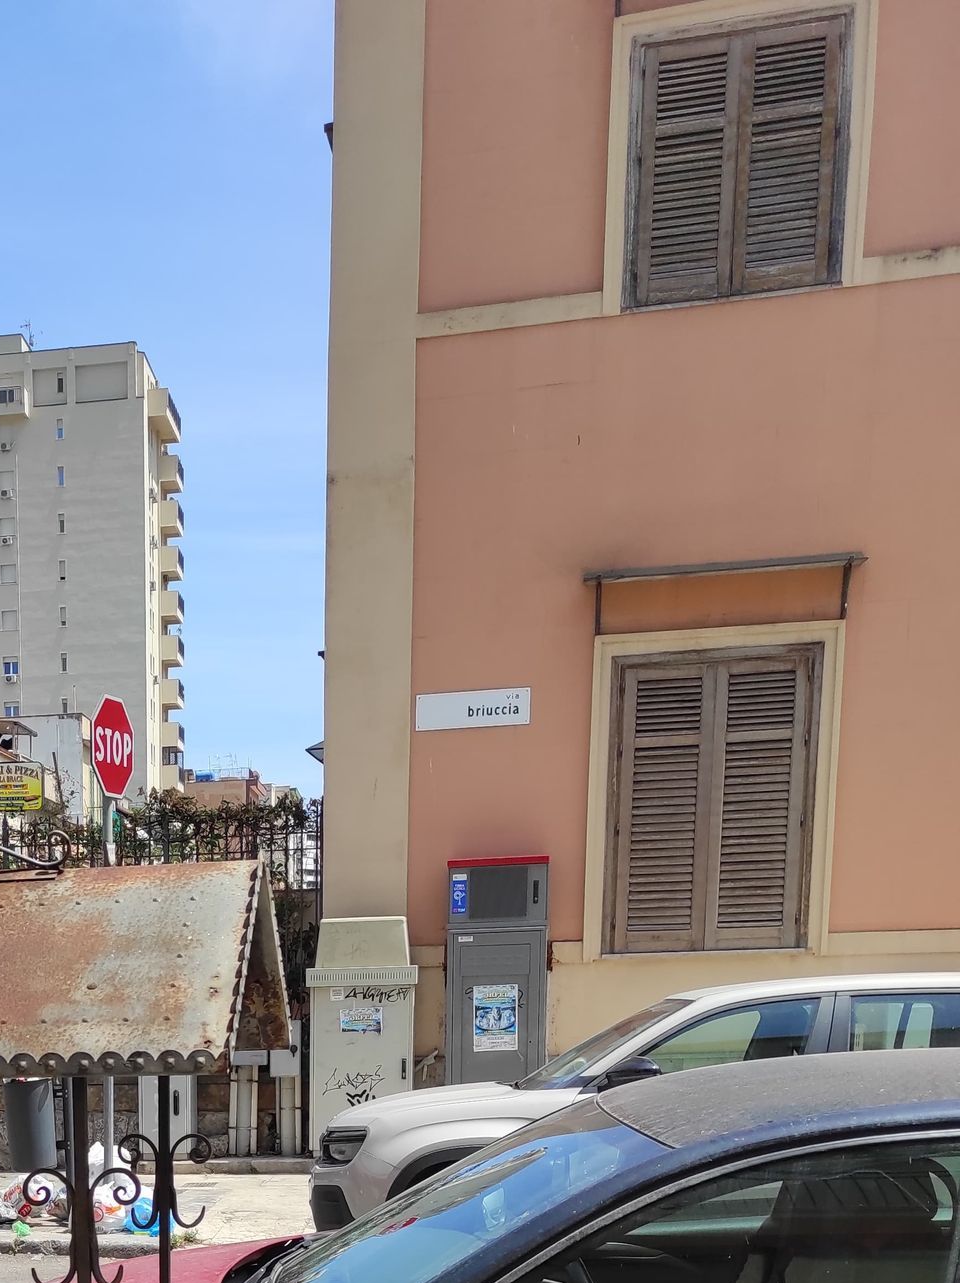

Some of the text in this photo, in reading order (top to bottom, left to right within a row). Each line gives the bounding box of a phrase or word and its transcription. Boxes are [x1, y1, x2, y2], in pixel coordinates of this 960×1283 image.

[505, 692, 520, 700] via
[467, 703, 520, 717] briuccia
[95, 725, 132, 768] STOP
[5, 765, 13, 775] &
[14, 765, 40, 781] PIZZA
